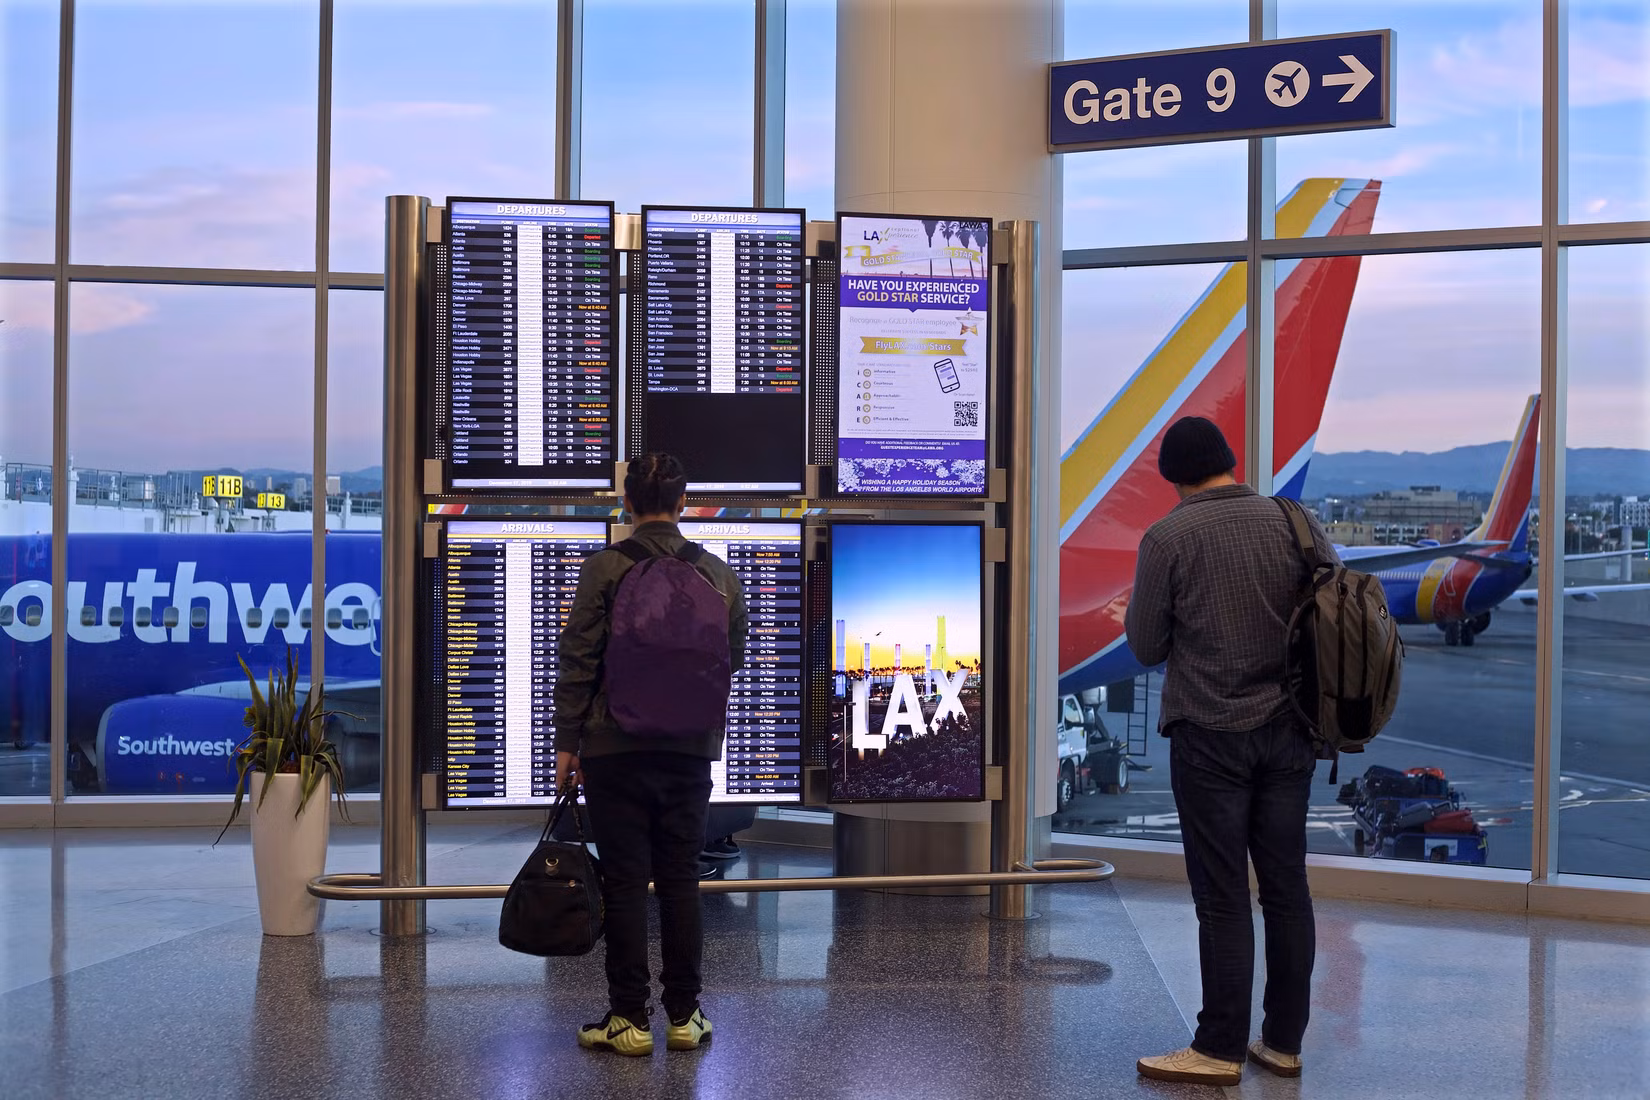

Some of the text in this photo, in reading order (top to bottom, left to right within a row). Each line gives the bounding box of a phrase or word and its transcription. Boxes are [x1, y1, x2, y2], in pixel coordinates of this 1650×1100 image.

[1063, 68, 1236, 124] Gate 9
[497, 205, 566, 215] DEPARTURES
[692, 213, 758, 223] DEPARTURES
[954, 250, 973, 258] STAR
[864, 256, 884, 266] GOLD
[848, 280, 979, 293] HAVE YOU EXPERIENCED
[858, 292, 970, 304] GOLD STAR SERVICE?
[204, 478, 215, 494] 11B
[220, 478, 241, 495] 11B
[271, 496, 281, 507] 13
[501, 524, 554, 533] ARRIVALS
[698, 525, 750, 534] ARRIVALS
[852, 669, 970, 749] LAX
[118, 735, 235, 757] Southwest
